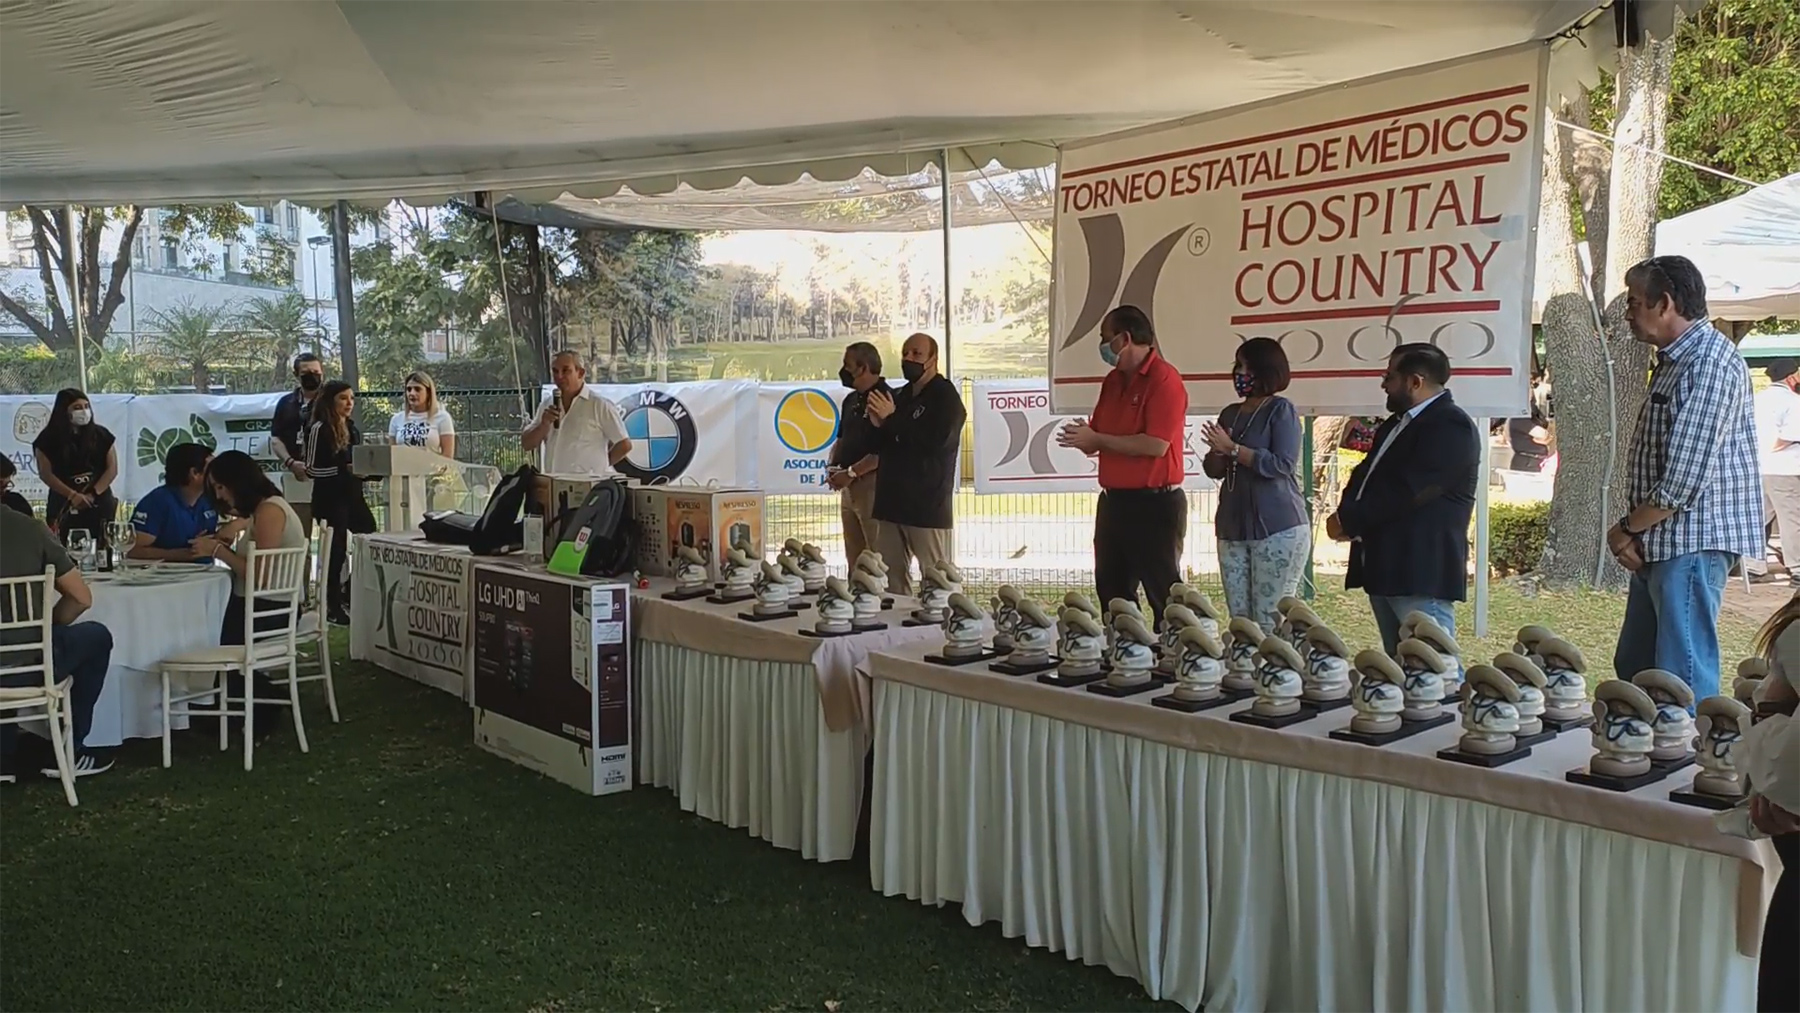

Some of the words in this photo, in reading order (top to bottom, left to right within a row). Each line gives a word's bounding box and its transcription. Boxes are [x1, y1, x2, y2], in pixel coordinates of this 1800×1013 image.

[1061, 169, 1167, 214] TORNEO
[1170, 148, 1289, 197] ESTATAL
[1295, 137, 1341, 175] DE
[1345, 104, 1528, 169] MÉDICOS
[1239, 176, 1502, 251] HOSPITAL
[1235, 241, 1501, 307] COUNTRY
[988, 395, 1047, 410] TORNEO
[245, 421, 272, 430] GRA
[229, 436, 272, 456] TE
[784, 459, 828, 470] ASOCIA
[800, 474, 815, 484] DE
[419, 553, 428, 570] DE
[408, 578, 460, 609] HOSPITAL
[479, 582, 491, 604] LG
[494, 585, 514, 608] UHD
[408, 605, 460, 638] COUNTRY
